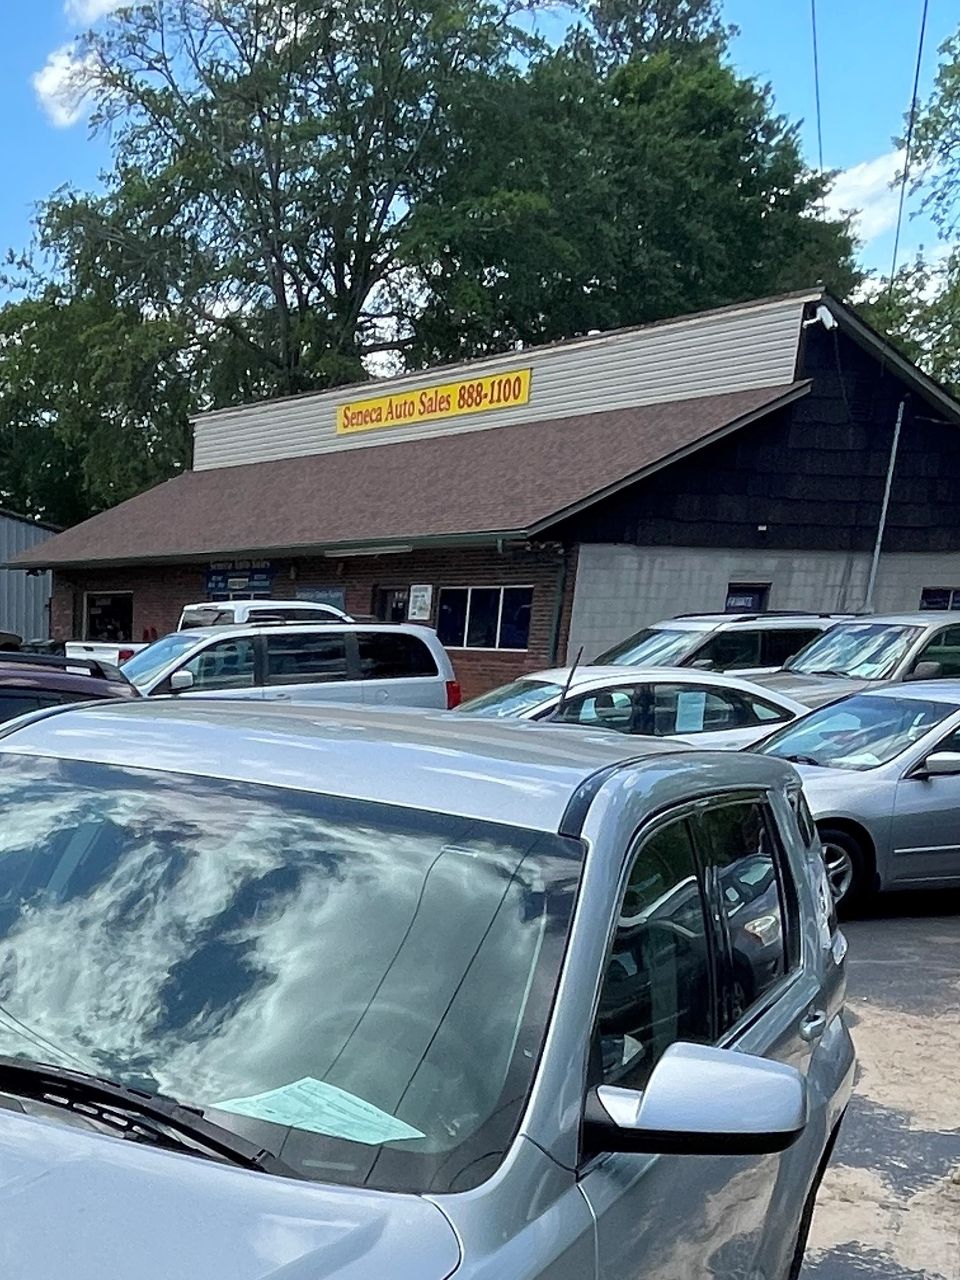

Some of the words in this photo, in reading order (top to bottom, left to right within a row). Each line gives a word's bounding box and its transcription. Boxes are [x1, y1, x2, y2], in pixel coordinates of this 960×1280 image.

[342, 406, 383, 429] Seneca
[385, 398, 415, 422] Auto
[418, 389, 451, 416] Sales
[457, 376, 521, 410] 888-1100
